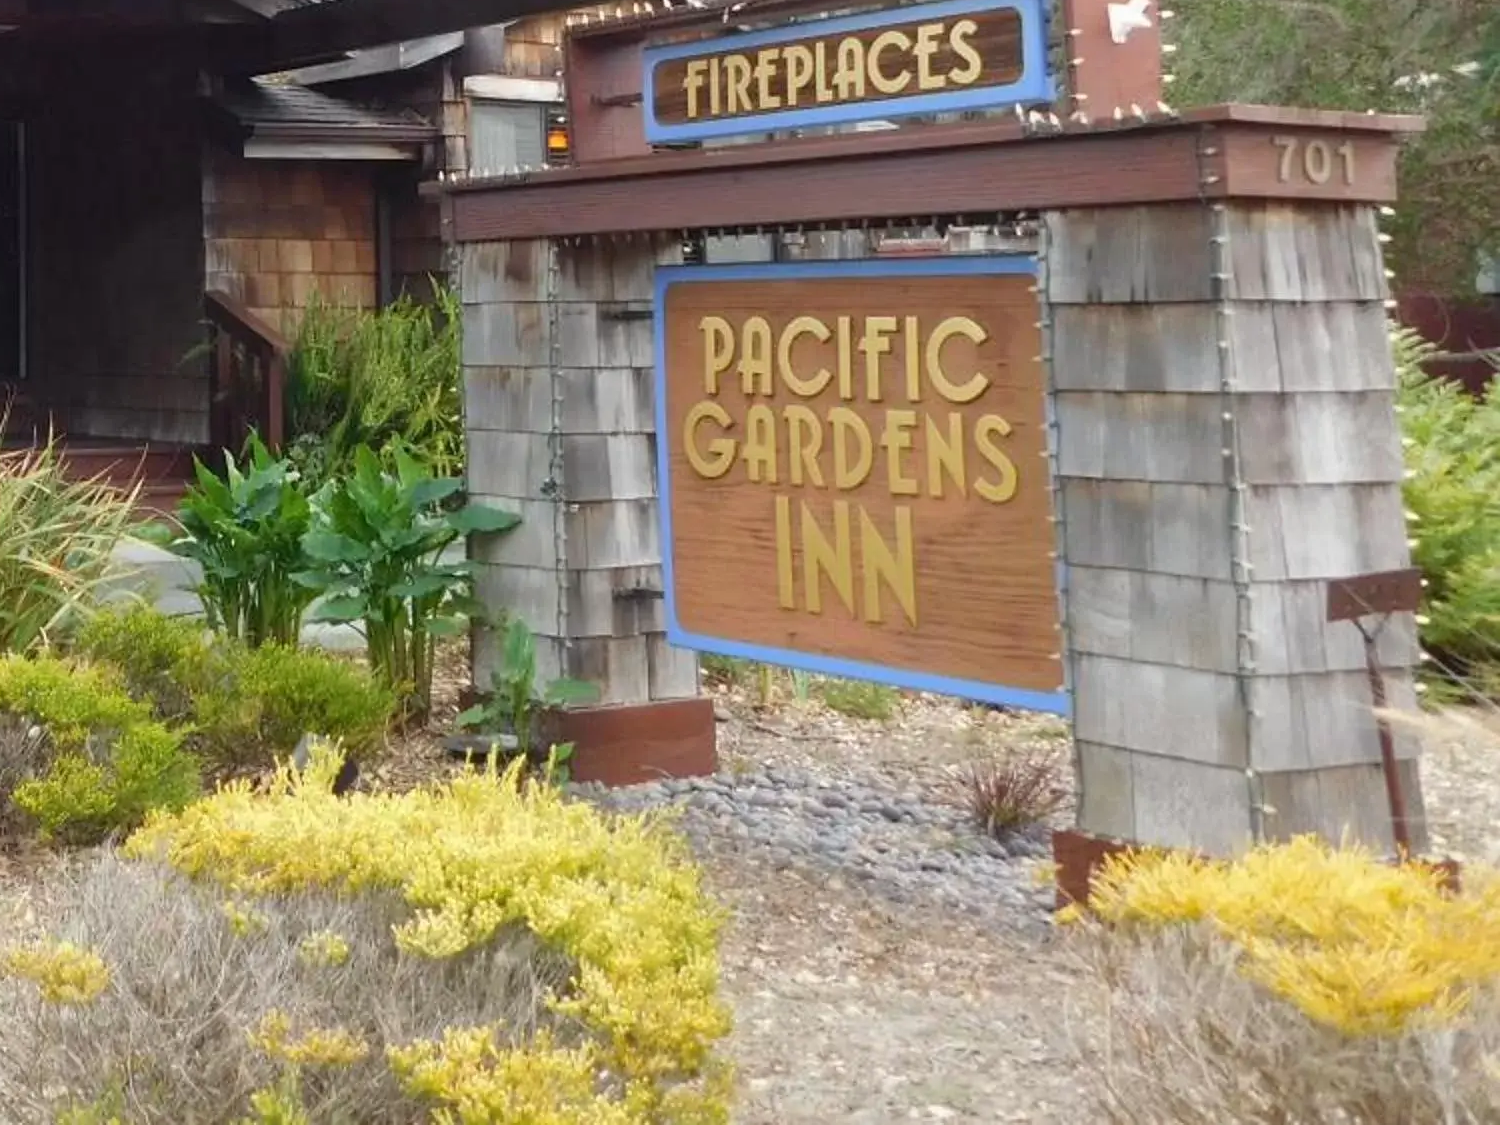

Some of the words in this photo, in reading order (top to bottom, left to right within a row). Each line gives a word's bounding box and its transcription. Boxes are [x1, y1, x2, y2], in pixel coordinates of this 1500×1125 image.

[683, 19, 982, 118] FIREPLACES
[1271, 135, 1356, 185] 701
[700, 315, 992, 403] PACIFIC
[684, 400, 1018, 503] GARDENS
[775, 494, 918, 628] INN
